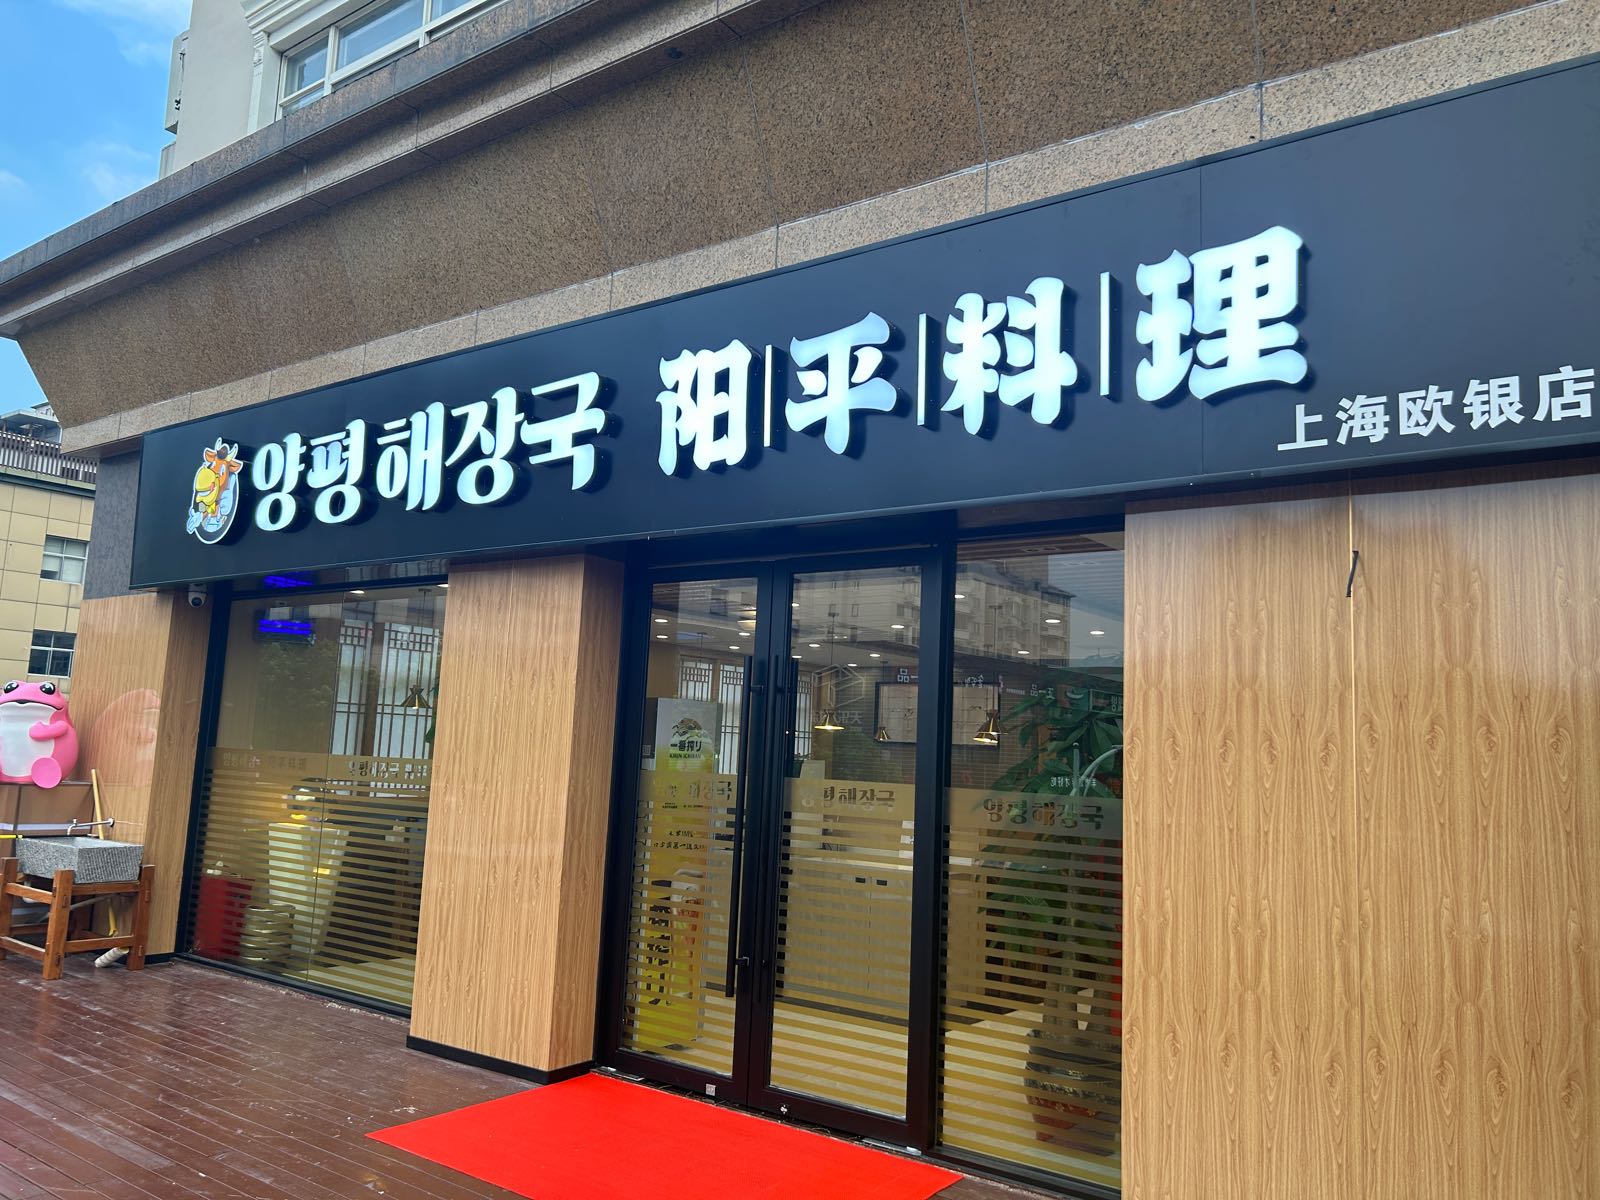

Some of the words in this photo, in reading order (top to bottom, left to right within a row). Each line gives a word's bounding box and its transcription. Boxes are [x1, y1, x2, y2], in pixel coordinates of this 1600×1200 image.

[252, 372, 606, 532] 양평해장국
[1277, 365, 1595, 451] 上海欧银店
